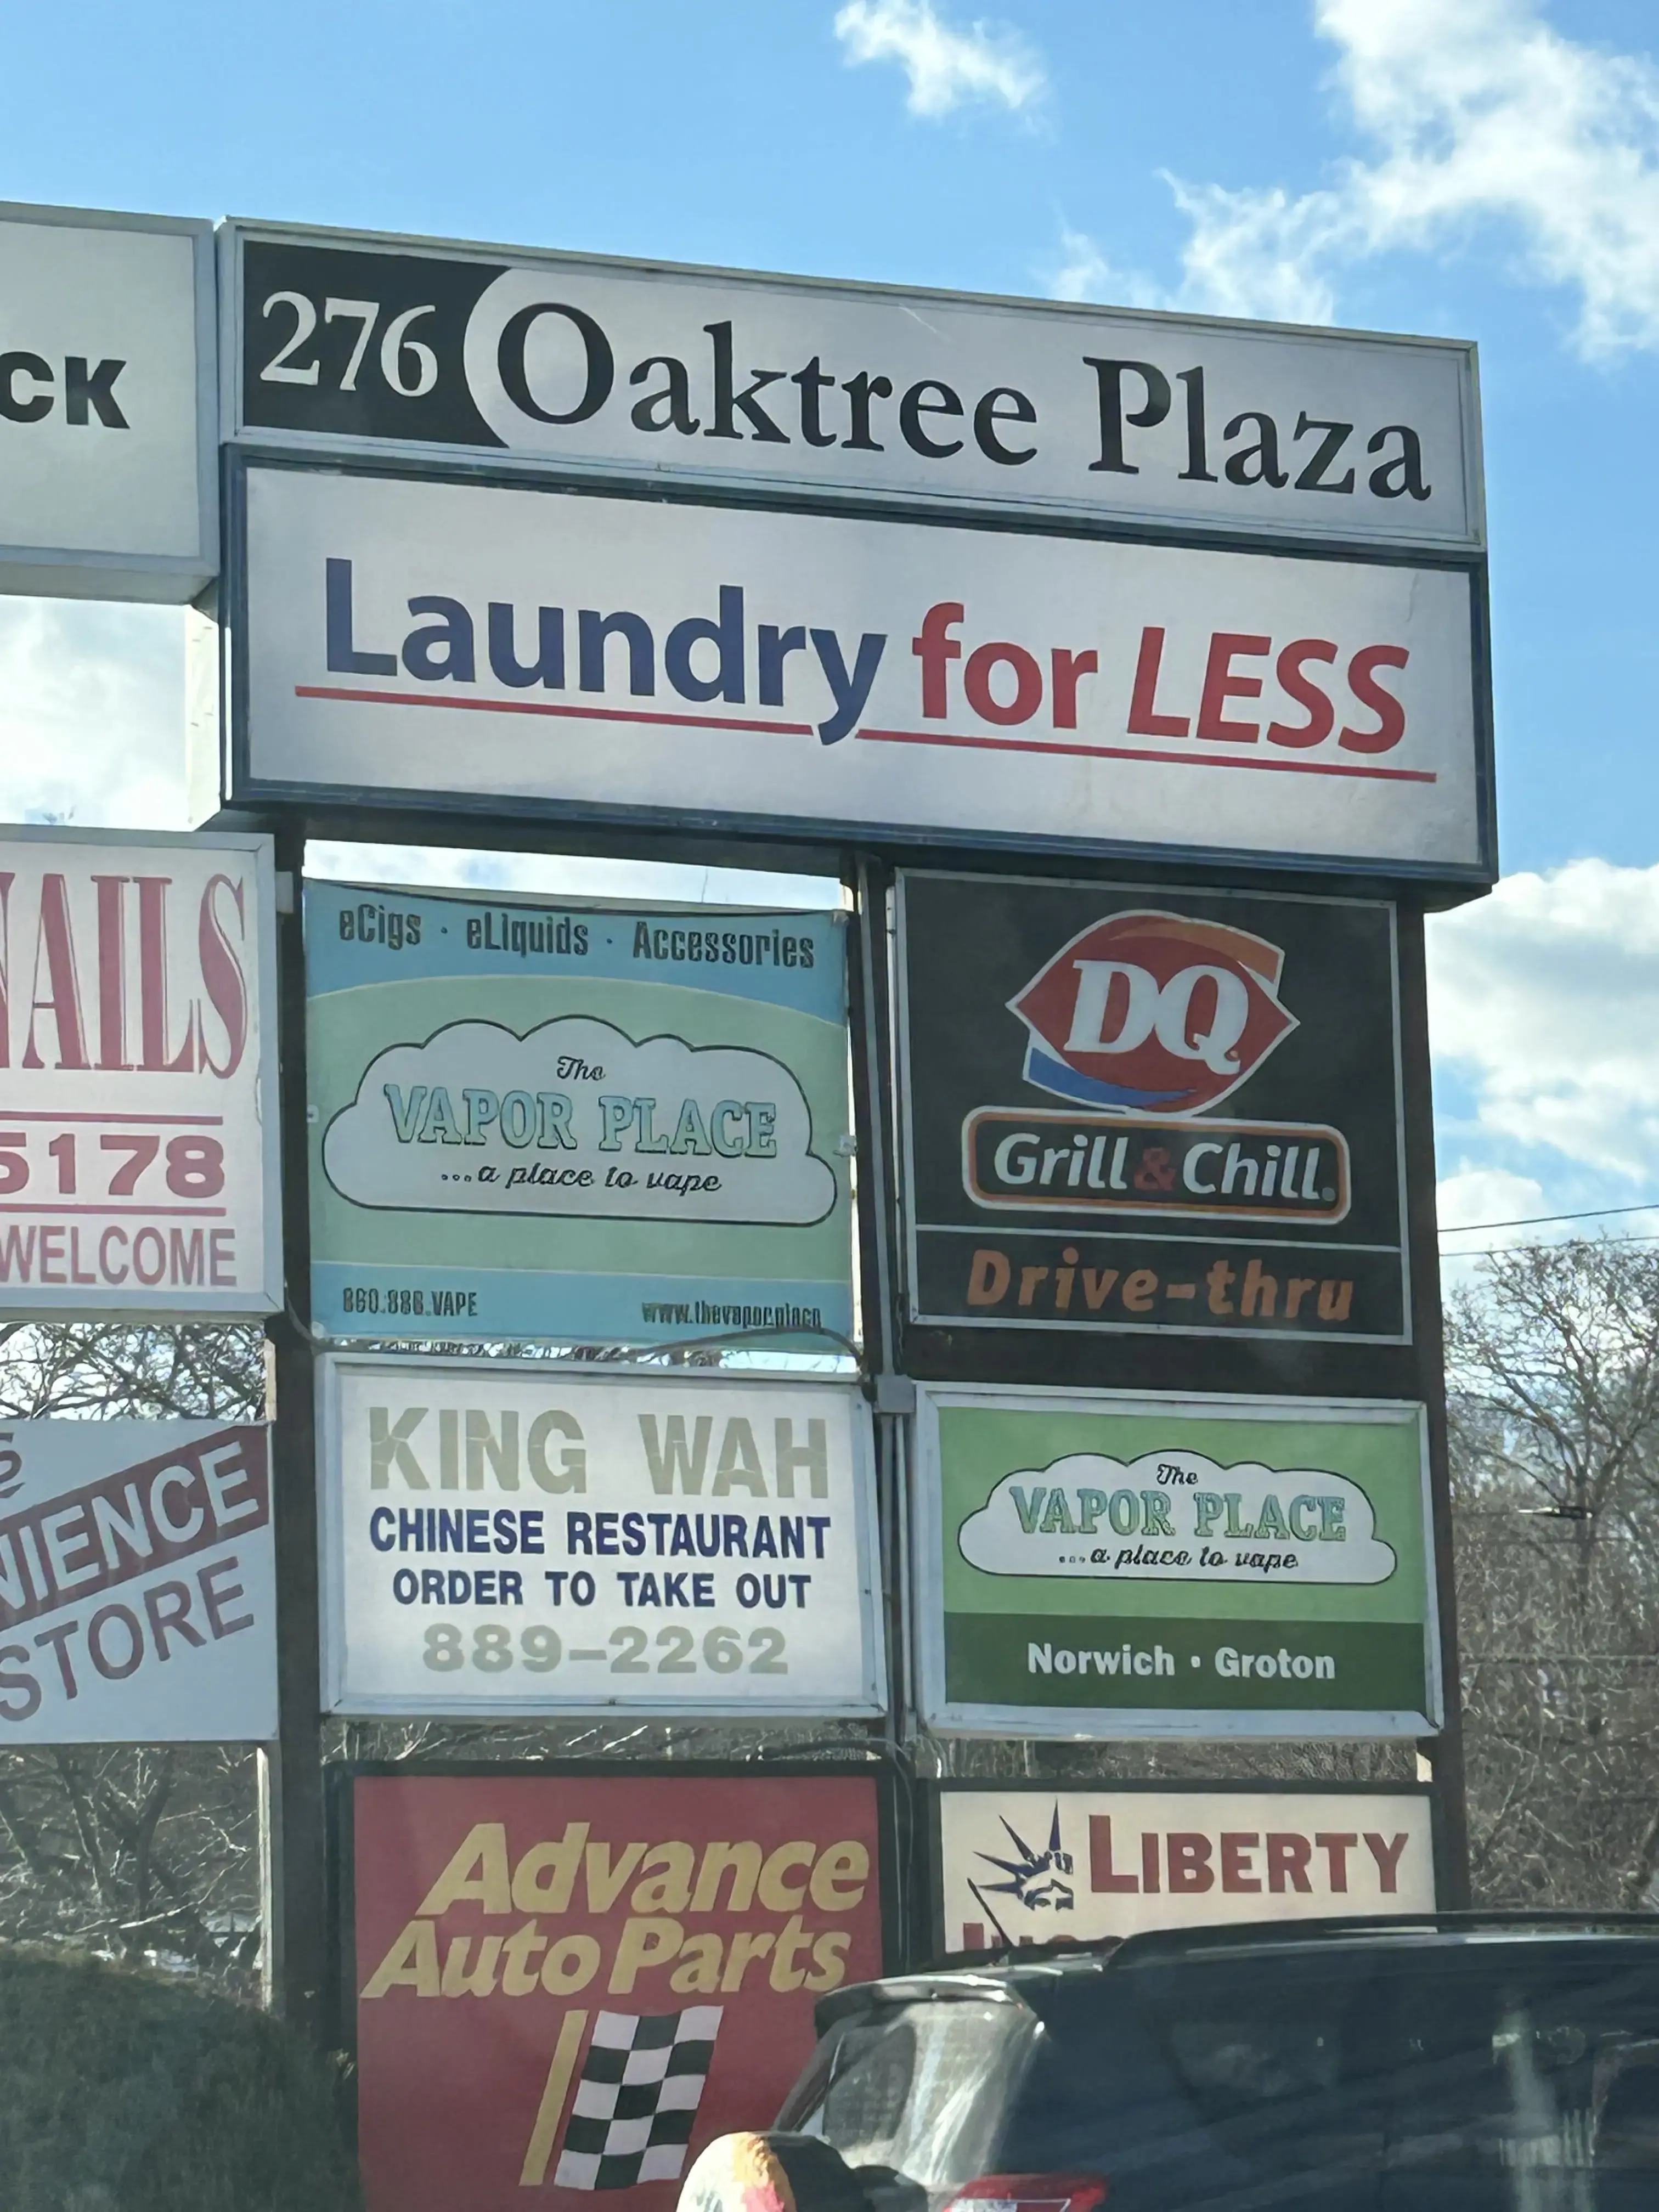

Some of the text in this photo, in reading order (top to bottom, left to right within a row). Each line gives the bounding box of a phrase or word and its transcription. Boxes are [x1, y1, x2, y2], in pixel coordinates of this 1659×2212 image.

[259, 291, 1432, 501] 276 Oaktree Plaza
[326, 557, 1410, 754] Laundry for LESS
[339, 904, 815, 968] eCigs eLiquids Accessories
[0, 872, 248, 1080] AILS
[1063, 960, 1250, 1075] DQ
[556, 1056, 606, 1081] The
[383, 1084, 777, 1159] VAPOR PLACE
[504, 1162, 595, 1189] place
[605, 1166, 639, 1189] to
[646, 1172, 722, 1197] vape
[994, 1133, 1128, 1189] Grill
[1133, 1147, 1176, 1191] &
[1, 1226, 237, 1288] WELCOME
[967, 1247, 1354, 1321] Drive-thru
[369, 1407, 828, 1499] KING WAH
[1156, 1463, 1198, 1485] The
[369, 1506, 831, 1559] CHINESE RESTAURANT
[1008, 1486, 1347, 1542] VAPOR PLACE
[392, 1568, 811, 1609] ORDER TO TAKE OUT
[1114, 1544, 1192, 1570] place
[1199, 1546, 1228, 1567] to
[1234, 1551, 1299, 1572] vape
[0, 1556, 255, 1722] STORE
[422, 1622, 788, 1675] 889-2262
[1028, 1643, 1335, 1680] Norwich Groton
[415, 1822, 869, 1915] Advance
[1088, 1814, 1409, 1894] LIBERTY
[359, 1914, 852, 1998] Auto Parts
